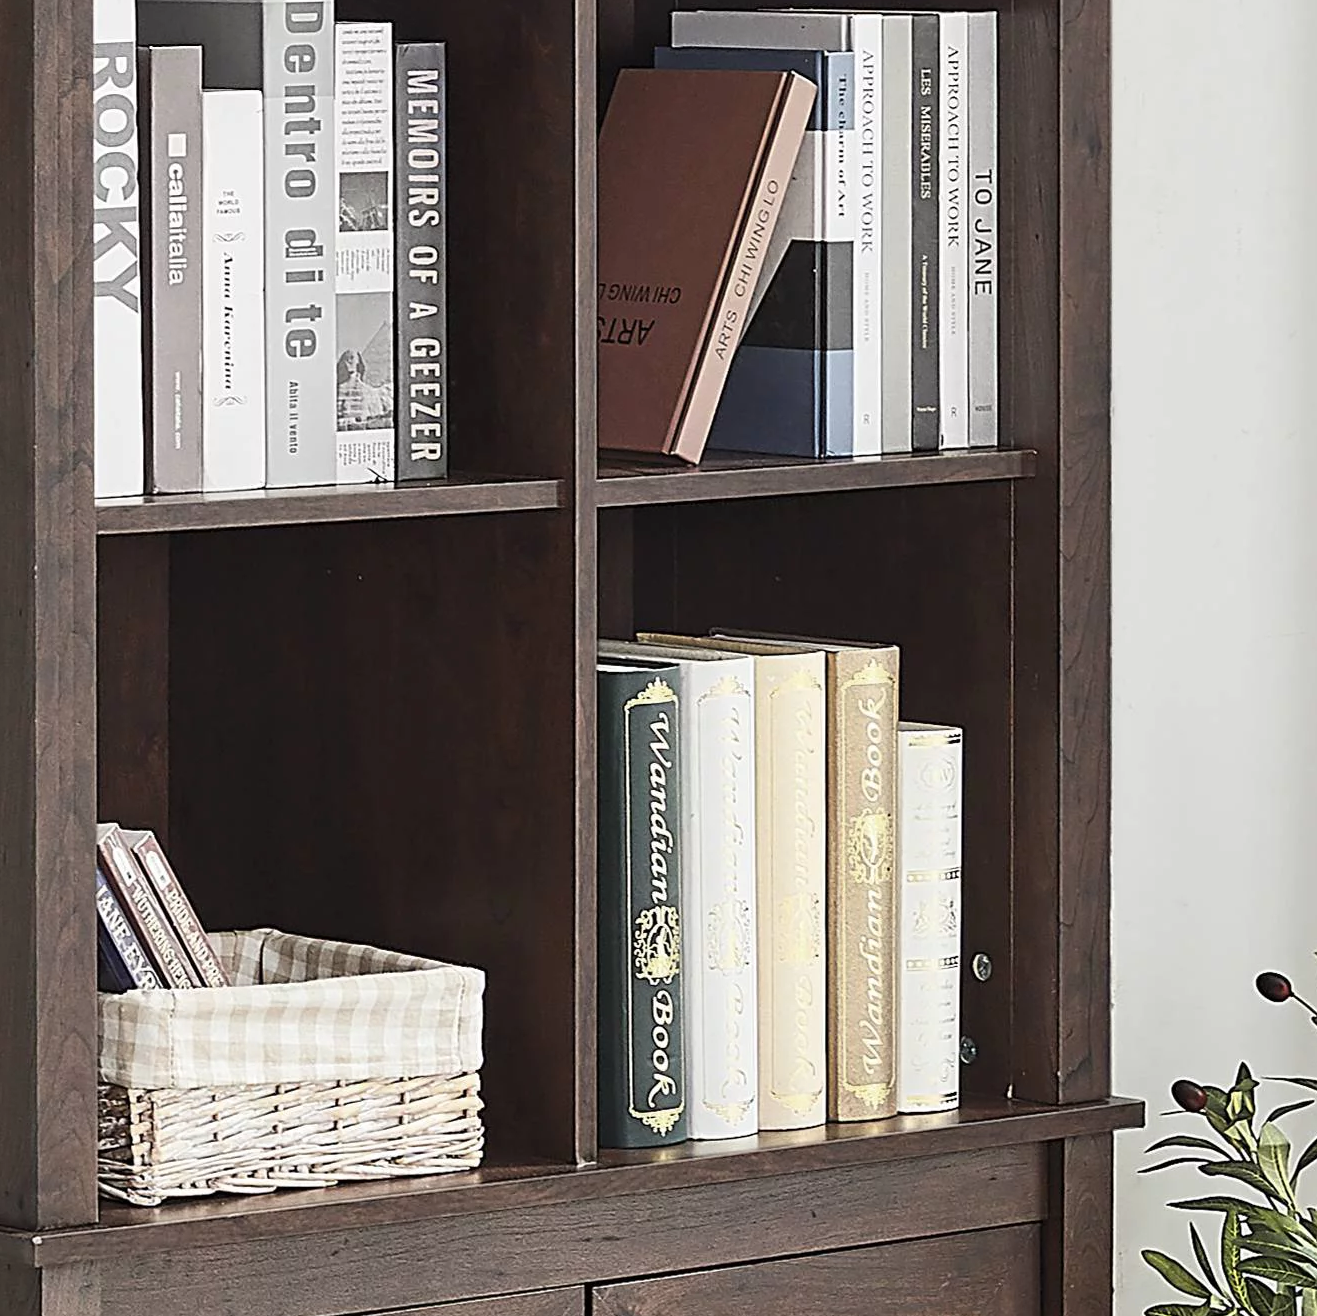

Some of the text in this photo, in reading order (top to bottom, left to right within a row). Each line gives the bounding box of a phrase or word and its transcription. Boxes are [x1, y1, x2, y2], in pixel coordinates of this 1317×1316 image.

[93, 41, 139, 315] ROCKY
[284, 1, 324, 358] Dentro di te
[837, 74, 848, 218] The charm of Art
[860, 49, 875, 254] APPROACH TO WORK
[920, 67, 932, 200] LES MISERABLES
[947, 45, 960, 248] APPROACH TO WORK
[406, 69, 442, 463] MEMOIRS OF A GEEZER
[606, 283, 651, 302] WING
[651, 286, 682, 304] CHI
[715, 179, 780, 361] ARTS CHI WING LO
[974, 168, 993, 296] TO JANE
[223, 251, 235, 389] Anna Karenina
[132, 883, 177, 963] WUTHERING
[166, 887, 197, 932] PRIDE
[187, 931, 210, 959] AND
[648, 711, 677, 1108] Wandian Book
[857, 685, 887, 1077] Wandian Book
